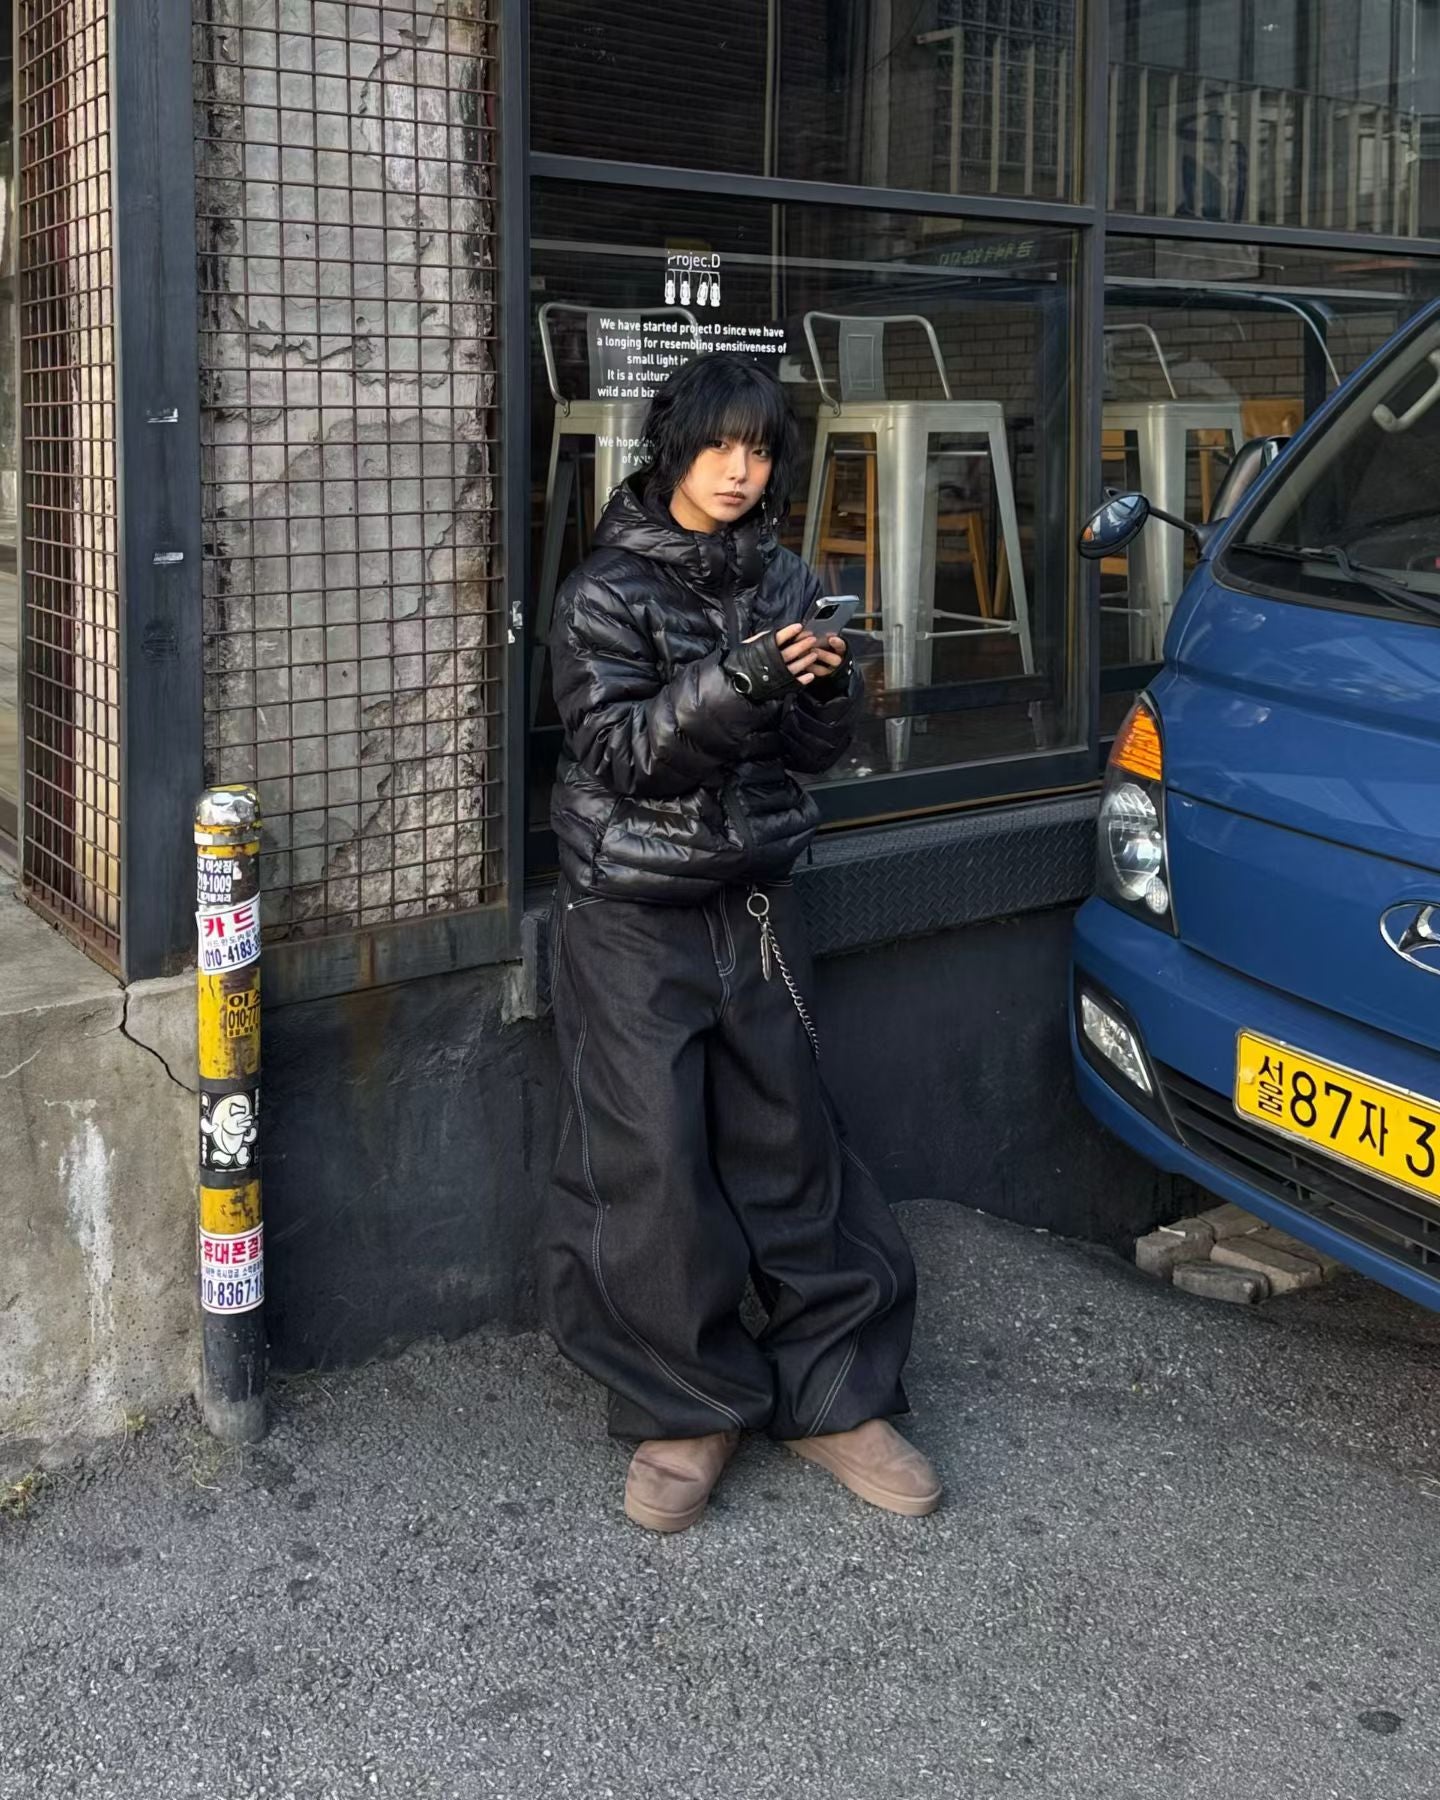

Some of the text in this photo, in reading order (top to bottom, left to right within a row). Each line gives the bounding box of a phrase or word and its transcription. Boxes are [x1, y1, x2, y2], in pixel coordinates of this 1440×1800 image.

[600, 319, 784, 338] We have started project D since we have
[597, 337, 786, 353] a longing for resembling sensitiveness of
[627, 354, 654, 364] small
[657, 354, 678, 368] light
[608, 370, 615, 380] It
[617, 370, 625, 380] is
[636, 371, 672, 382] cultura
[598, 387, 659, 397] wild and biz
[598, 436, 613, 448] We
[622, 453, 632, 464] of
[1257, 1055, 1284, 1118] 서울
